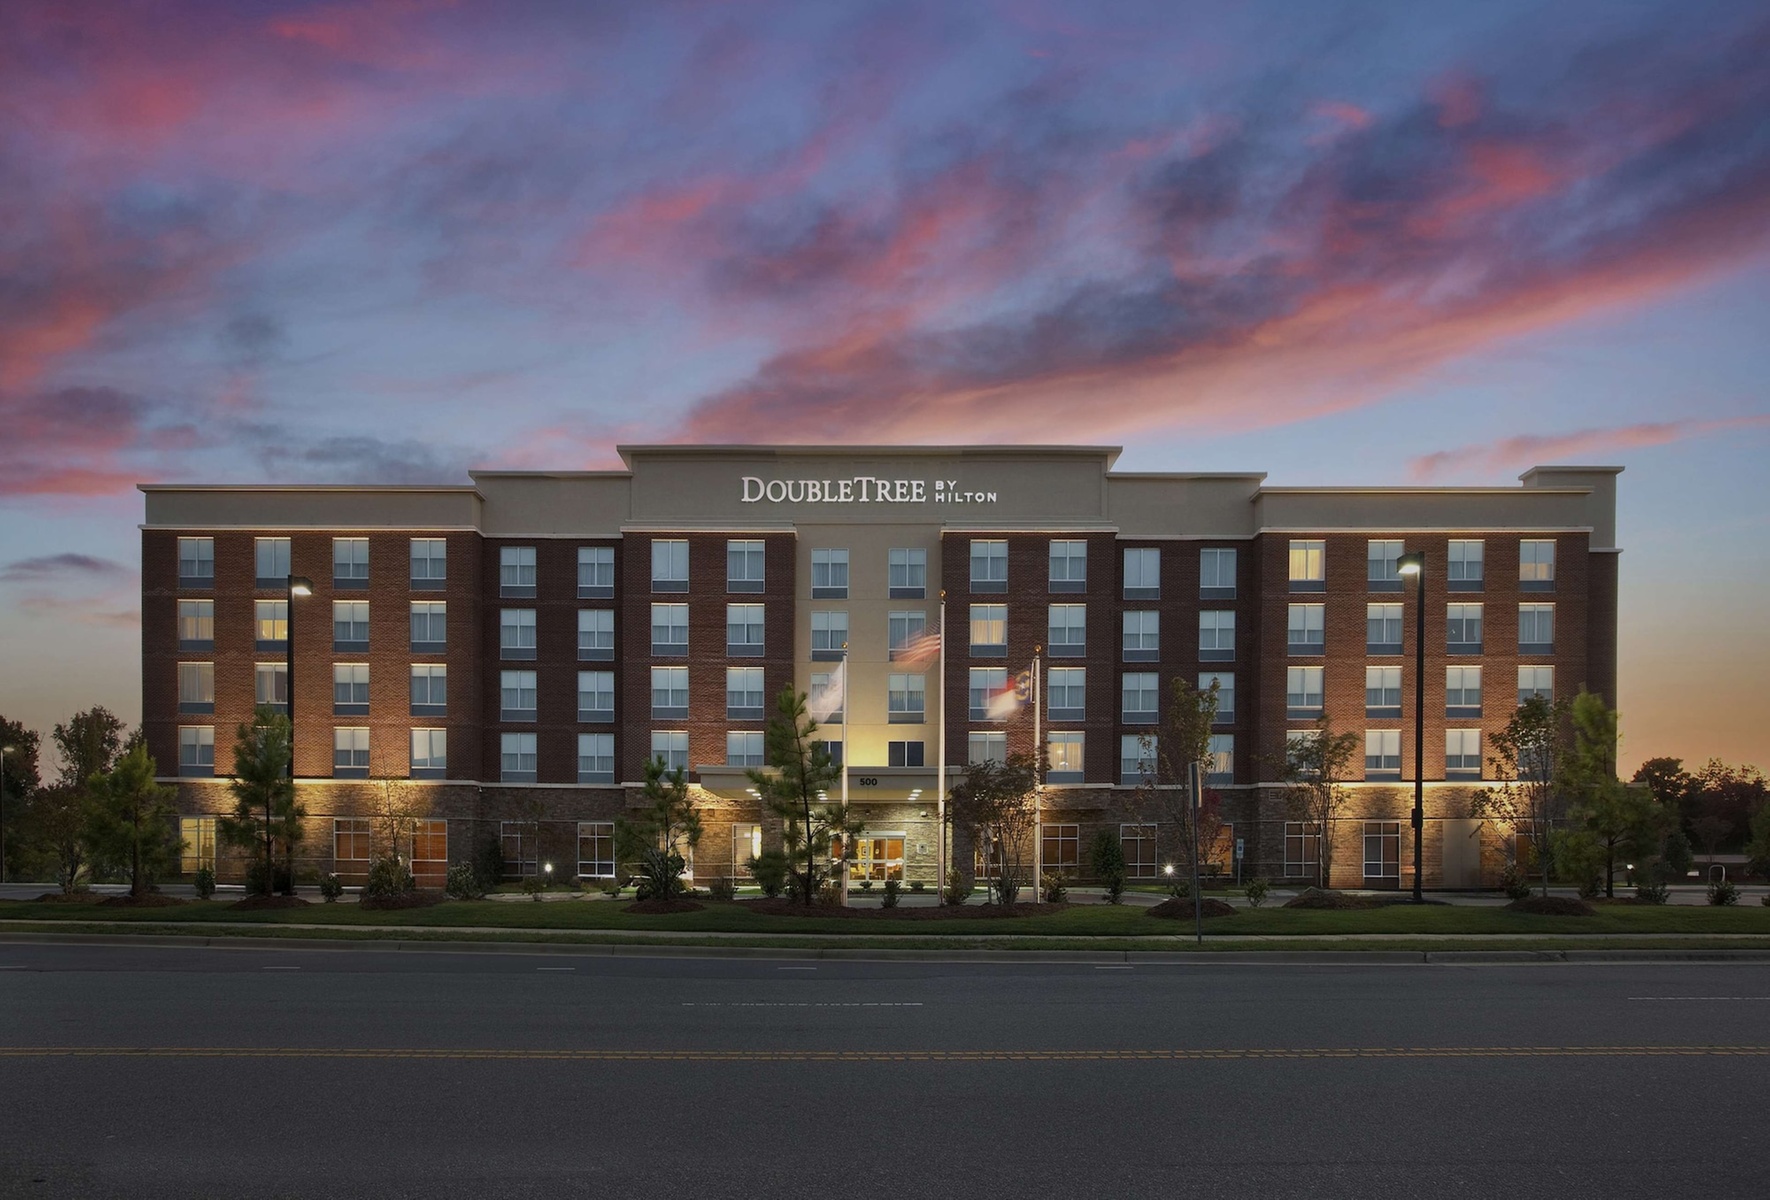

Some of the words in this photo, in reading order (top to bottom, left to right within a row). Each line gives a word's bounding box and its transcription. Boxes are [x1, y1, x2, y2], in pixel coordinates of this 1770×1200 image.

[741, 476, 927, 503] DOUBLETREE
[935, 480, 957, 491] BY
[935, 492, 997, 503] HILTON
[859, 777, 878, 786] 500
